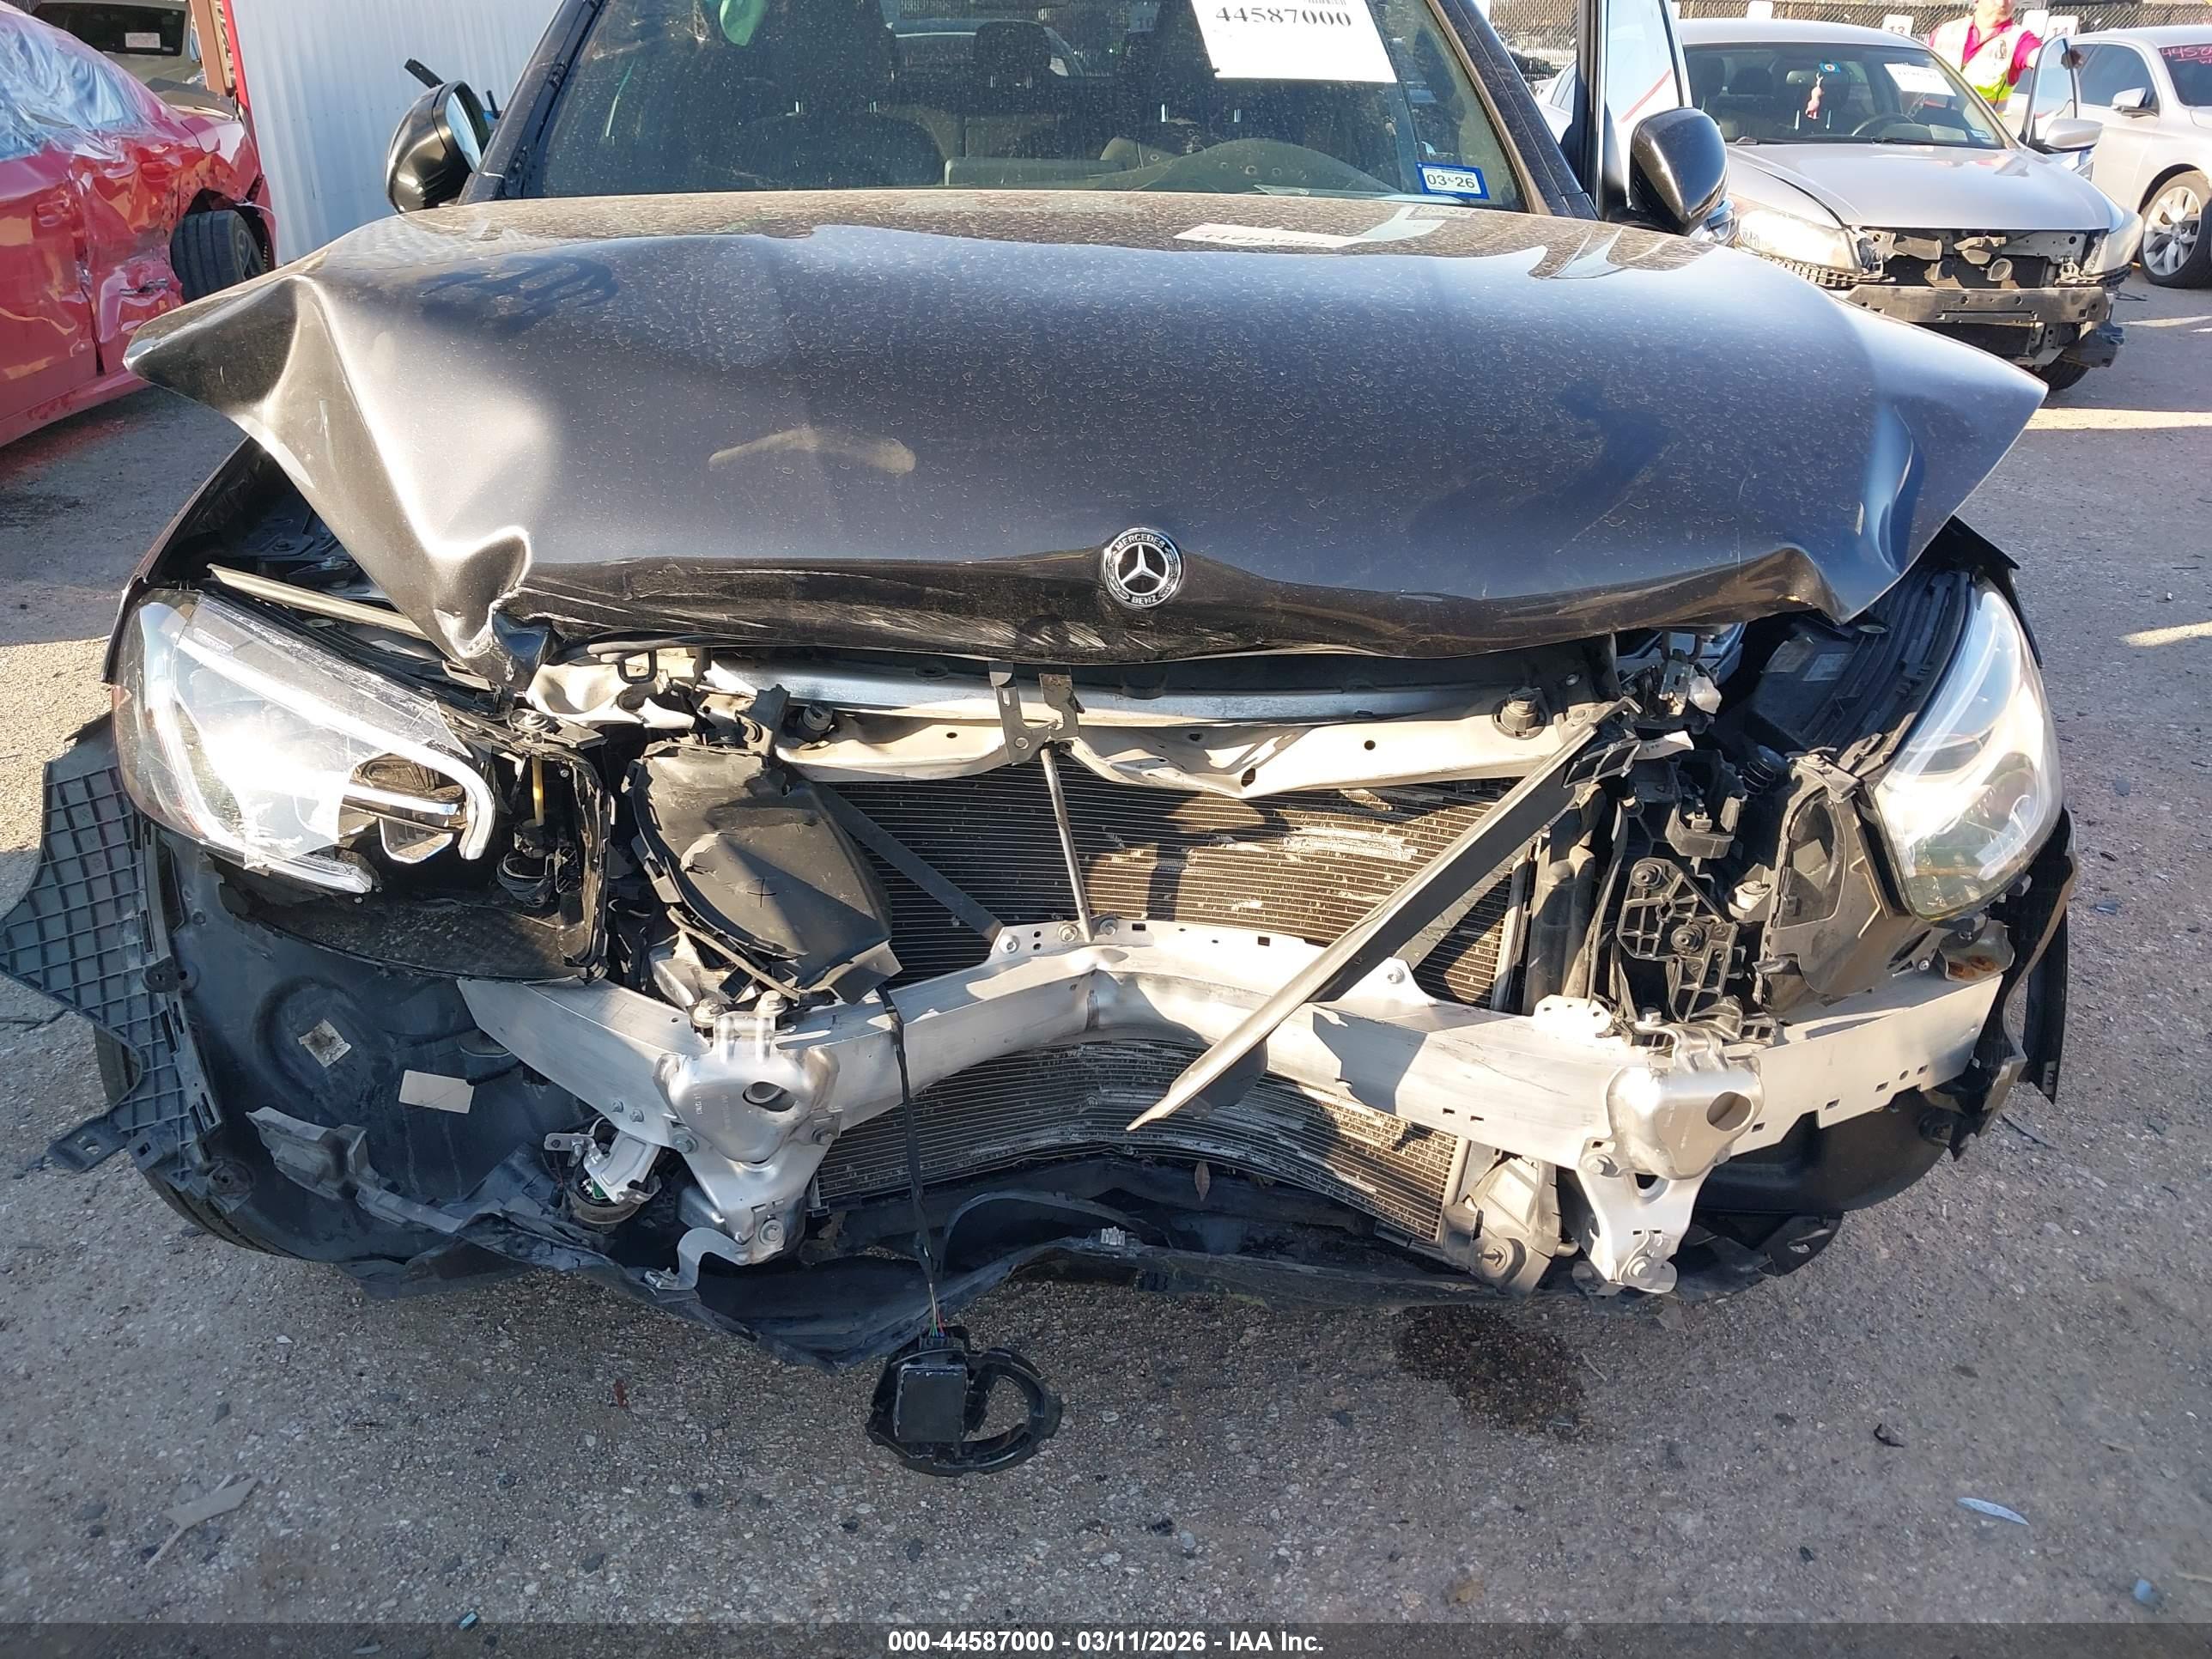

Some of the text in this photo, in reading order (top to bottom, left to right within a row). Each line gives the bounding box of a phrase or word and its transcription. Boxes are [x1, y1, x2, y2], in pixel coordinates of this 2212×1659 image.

[1215, 7, 1352, 27] 44587000
[1115, 533, 1166, 550] MERCEDES
[1130, 594, 1158, 605] BENZ
